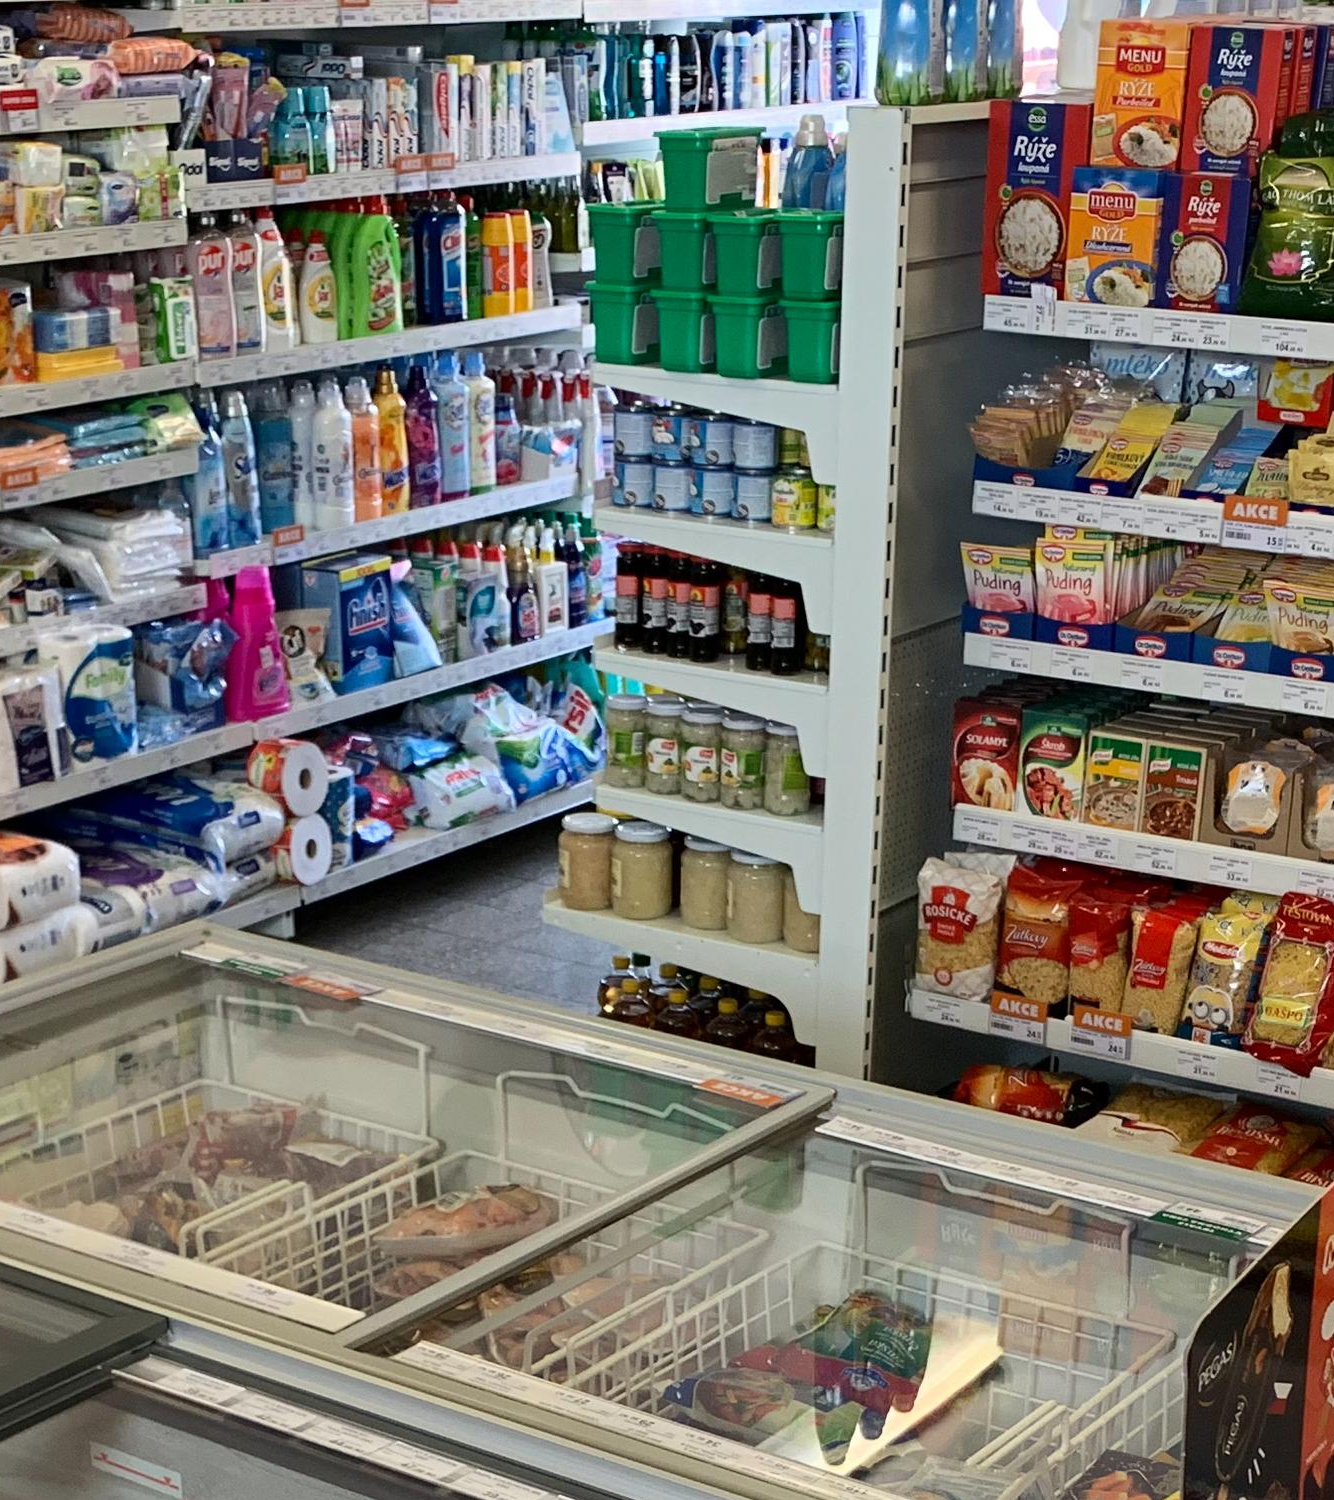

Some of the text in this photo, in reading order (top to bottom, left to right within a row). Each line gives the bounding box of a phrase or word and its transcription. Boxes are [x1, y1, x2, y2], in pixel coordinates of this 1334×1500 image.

[1119, 47, 1164, 65] MENU
[1217, 48, 1254, 73] Rýže
[1127, 62, 1154, 74] GOLD
[1014, 134, 1057, 163] Rýže
[1089, 193, 1136, 211] menu
[1187, 196, 1222, 218] Rýže
[198, 250, 226, 278] pur
[1233, 503, 1279, 520] AKCE
[973, 571, 1022, 596] Puding
[1044, 569, 1093, 595] Puding
[1278, 608, 1330, 634] Puding
[926, 904, 972, 926] ROSICKÉ
[999, 999, 1039, 1017] AKCE
[1082, 1013, 1123, 1031] AKCE
[1197, 1340, 1237, 1393] PEGAS
[1224, 1398, 1247, 1457] PEGAS
